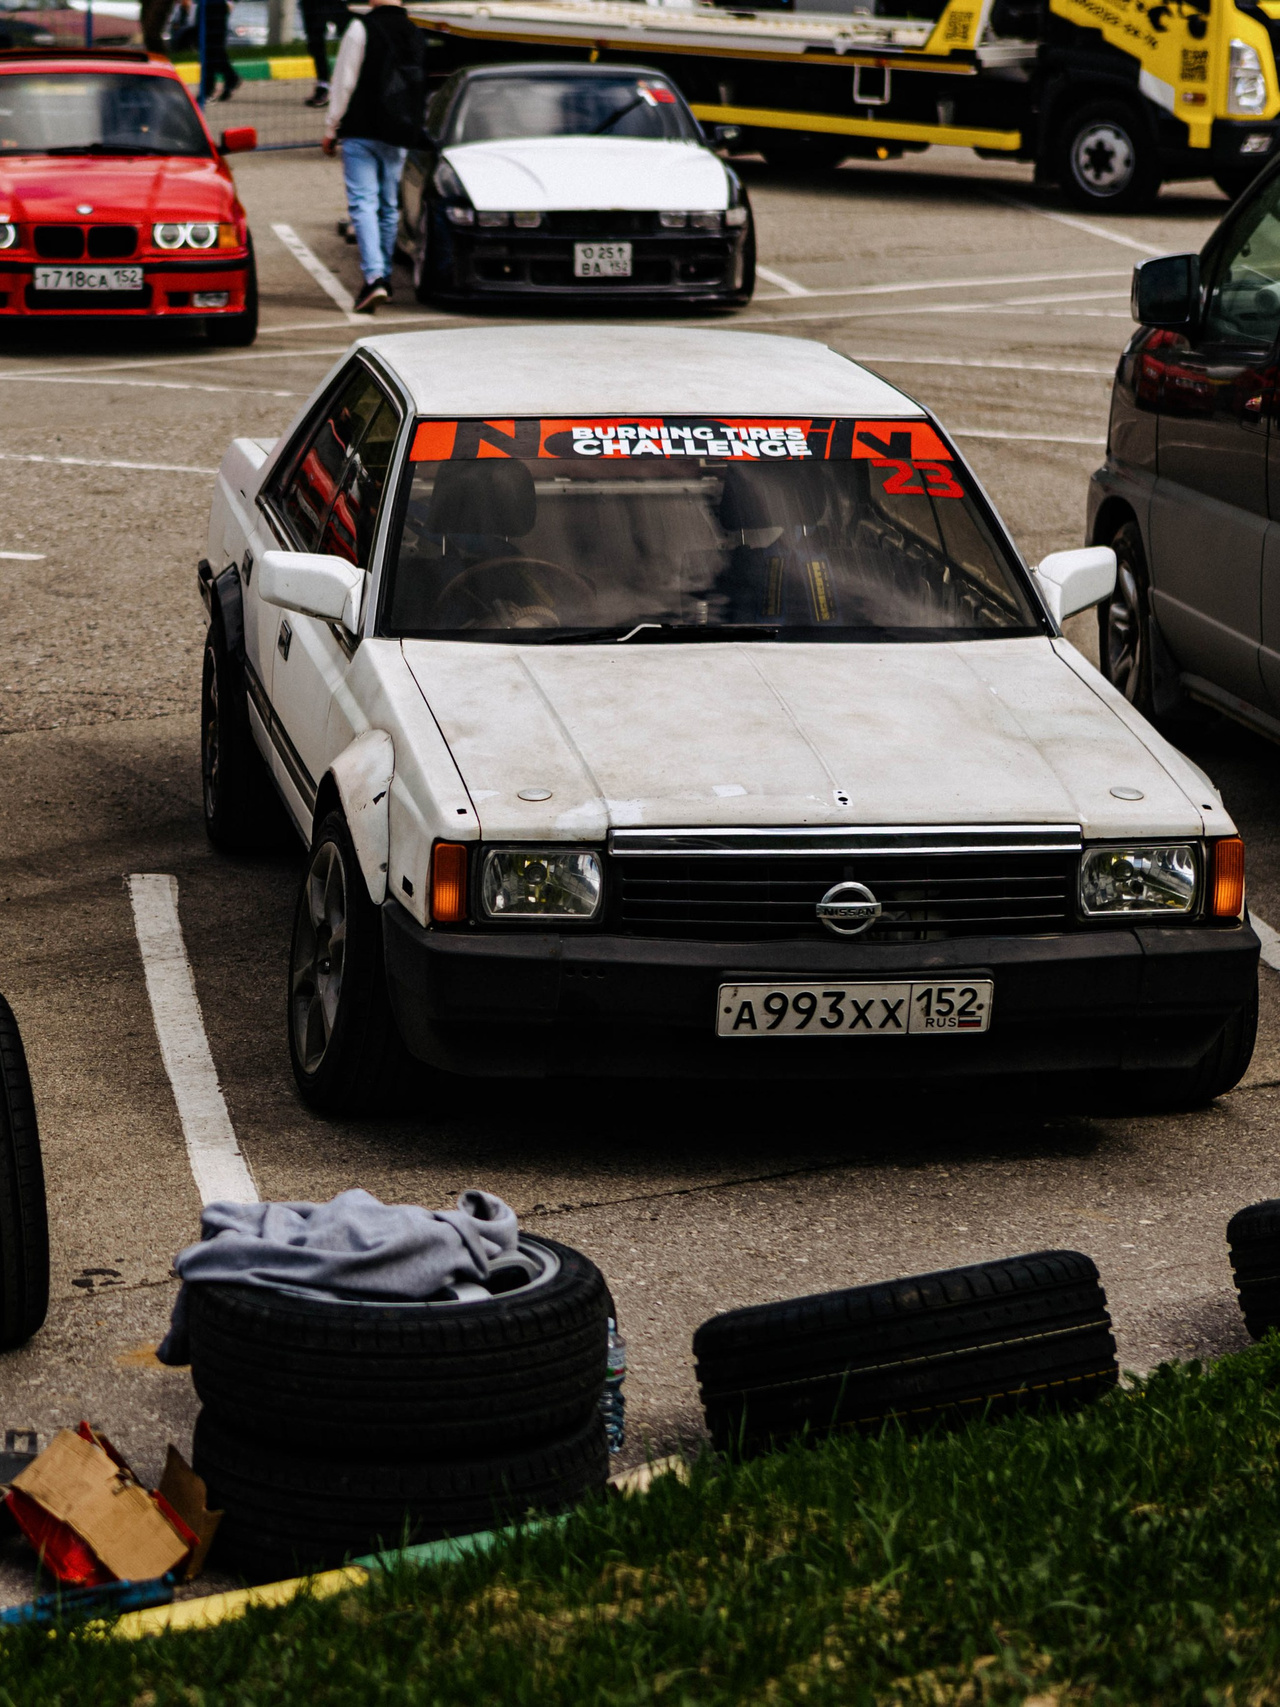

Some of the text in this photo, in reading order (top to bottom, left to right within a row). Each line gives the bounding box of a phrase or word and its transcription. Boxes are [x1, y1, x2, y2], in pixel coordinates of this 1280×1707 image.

[114, 270, 137, 283] 152
[571, 426, 805, 441] BURNING TIRES
[572, 439, 813, 457] CHALLENGE
[871, 459, 965, 499] 23
[823, 907, 876, 918] NISSAN
[916, 987, 979, 1017] 152
[925, 1017, 957, 1028] RUS
